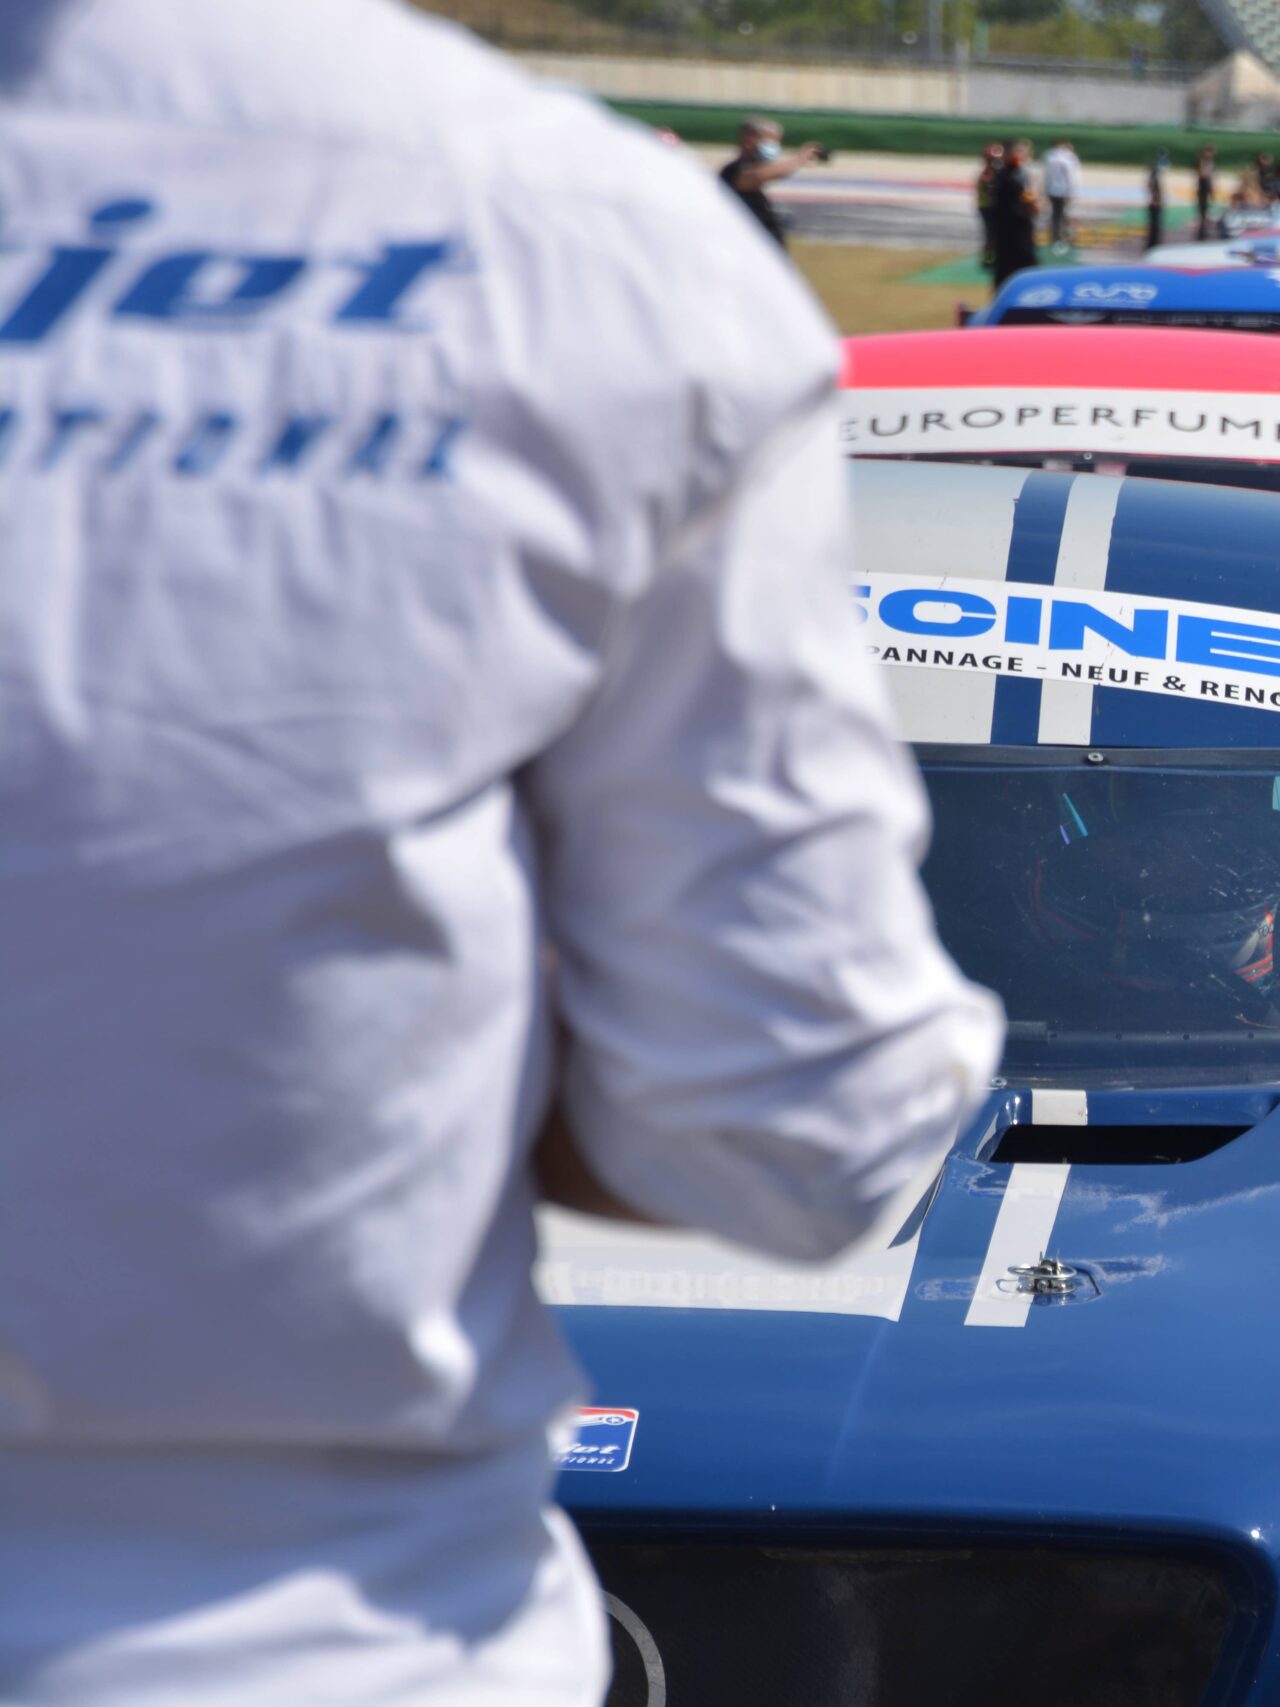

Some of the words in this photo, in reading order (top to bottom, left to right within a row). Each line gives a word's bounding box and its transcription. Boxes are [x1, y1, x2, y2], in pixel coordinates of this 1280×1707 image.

[0, 408, 466, 478] TIONAL
[1060, 661, 1150, 690] NEUF
[1163, 674, 1187, 693] &
